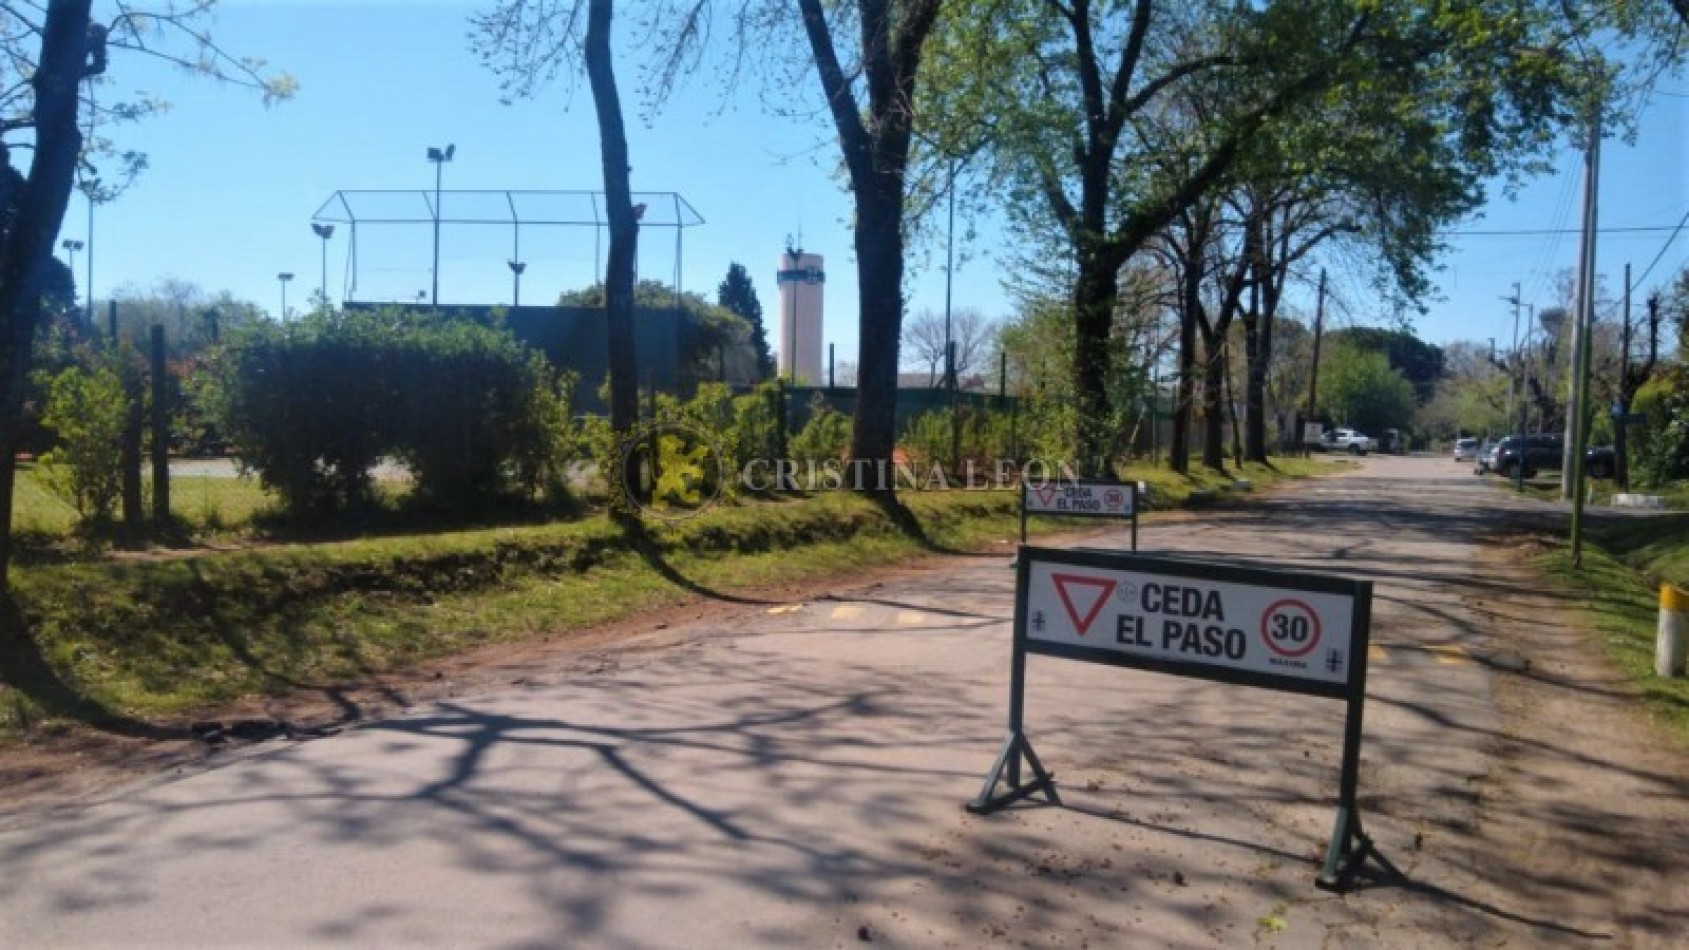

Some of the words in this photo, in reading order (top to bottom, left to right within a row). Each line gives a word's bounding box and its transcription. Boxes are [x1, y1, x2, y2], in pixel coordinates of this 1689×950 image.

[1140, 582, 1225, 622] CEDA
[1115, 614, 1153, 647] EL
[1161, 620, 1246, 660] PASO
[1272, 613, 1308, 643] 30
